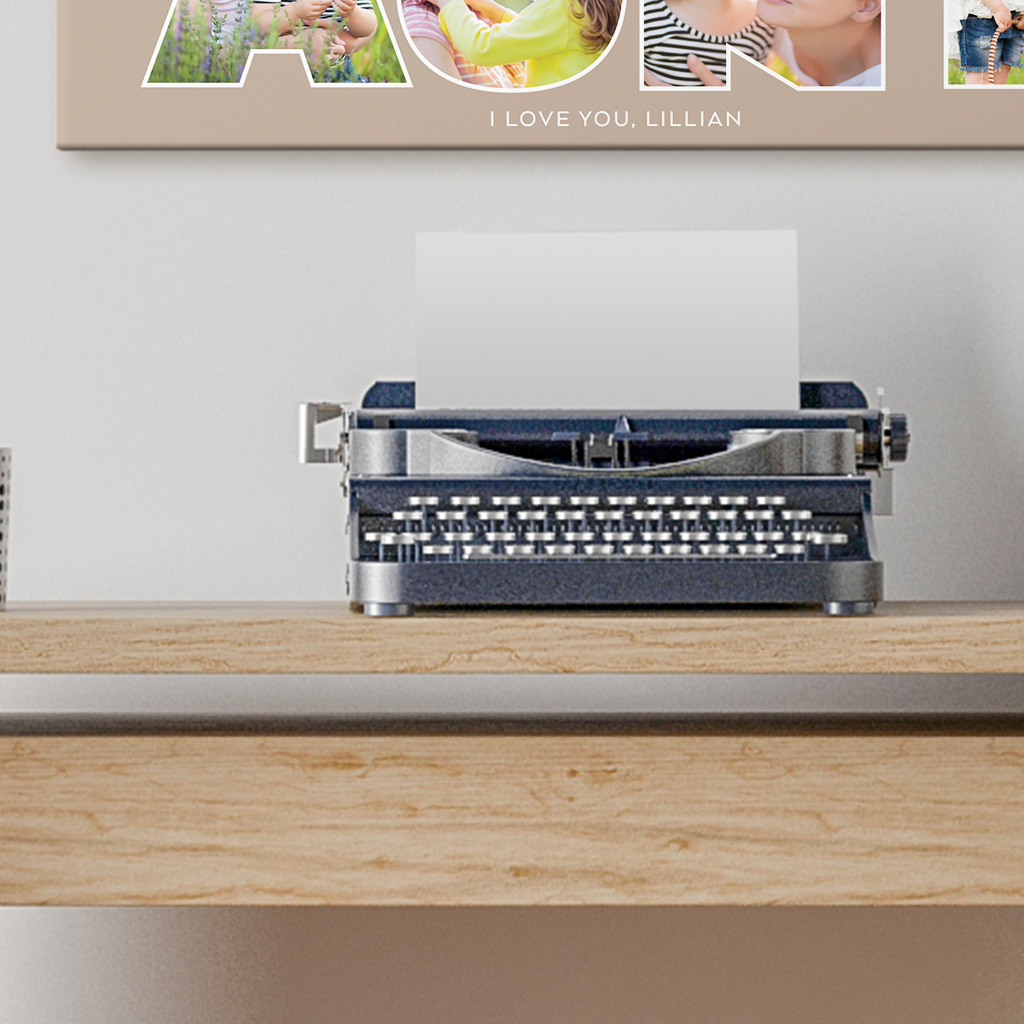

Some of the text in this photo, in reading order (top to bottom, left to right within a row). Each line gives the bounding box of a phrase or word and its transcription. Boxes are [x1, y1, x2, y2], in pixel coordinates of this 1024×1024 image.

[490, 110, 741, 130] I LOVE YOU, LILLIAN
